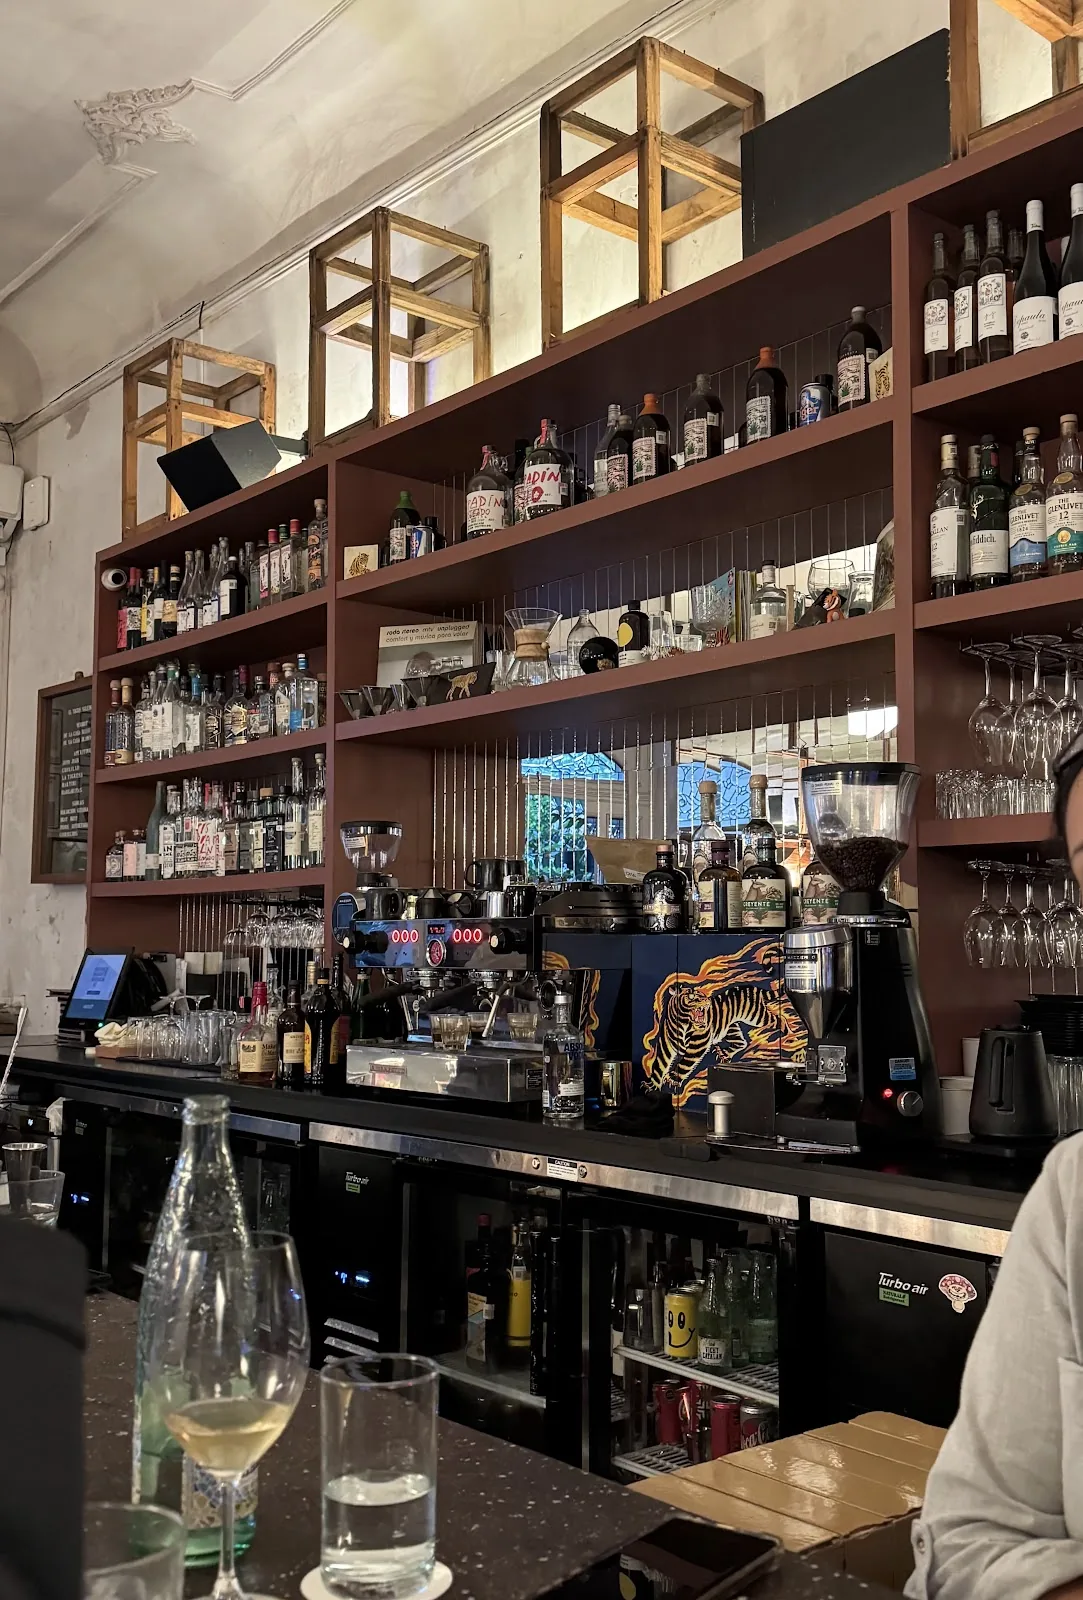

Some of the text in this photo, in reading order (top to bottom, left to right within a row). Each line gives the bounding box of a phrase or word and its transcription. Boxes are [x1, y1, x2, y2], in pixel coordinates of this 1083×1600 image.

[1047, 503, 1083, 515] GLENLIVET
[1010, 512, 1040, 524] GLENLIVET
[1059, 510, 1069, 520] 12
[437, 624, 470, 632] unplugged
[437, 632, 452, 640] para
[878, 1272, 929, 1295] Turbo air
